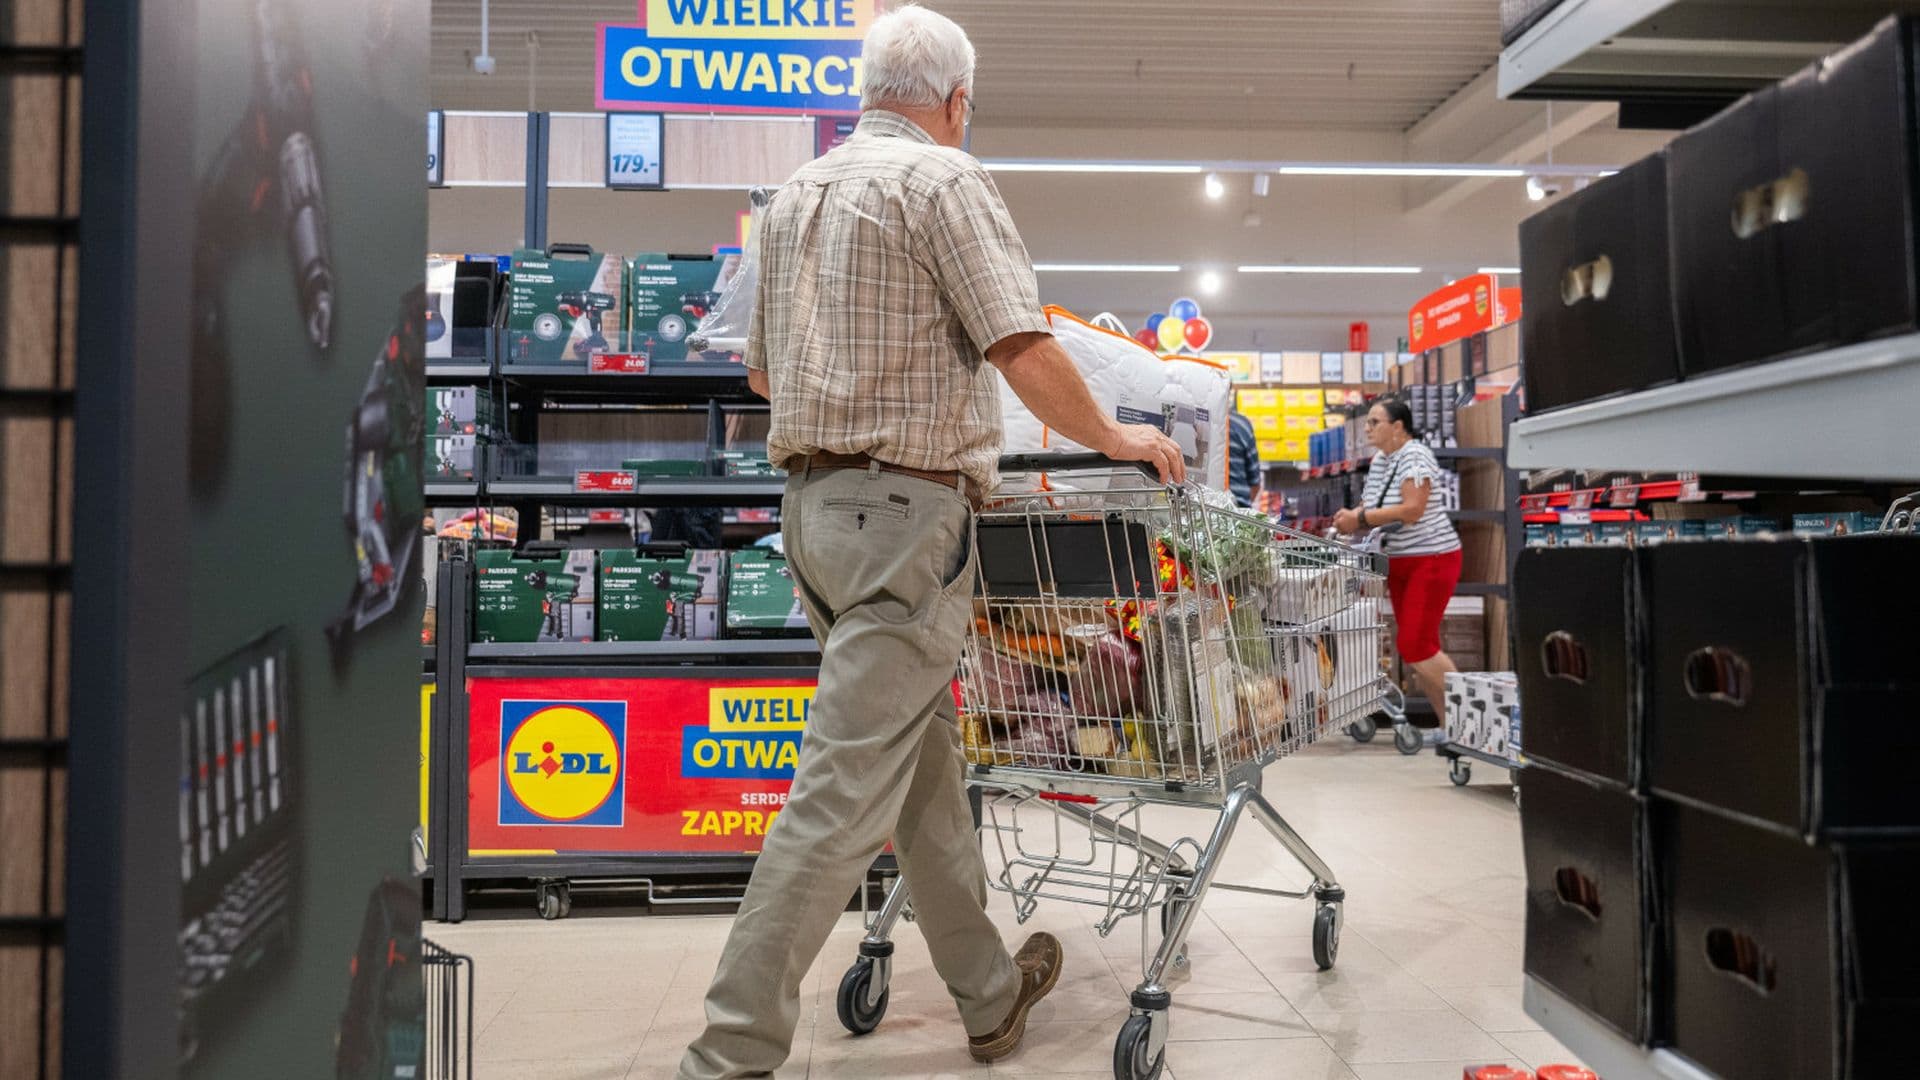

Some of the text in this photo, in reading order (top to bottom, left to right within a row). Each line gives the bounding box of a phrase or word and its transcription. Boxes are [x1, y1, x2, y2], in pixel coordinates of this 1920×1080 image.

[666, 0, 856, 27] WIELKIE
[620, 46, 864, 97] OTWARCI
[612, 154, 658, 173] 179.-
[488, 567, 518, 575] PARKSIDE
[692, 738, 800, 769] OTWA
[741, 792, 789, 805] SERDE
